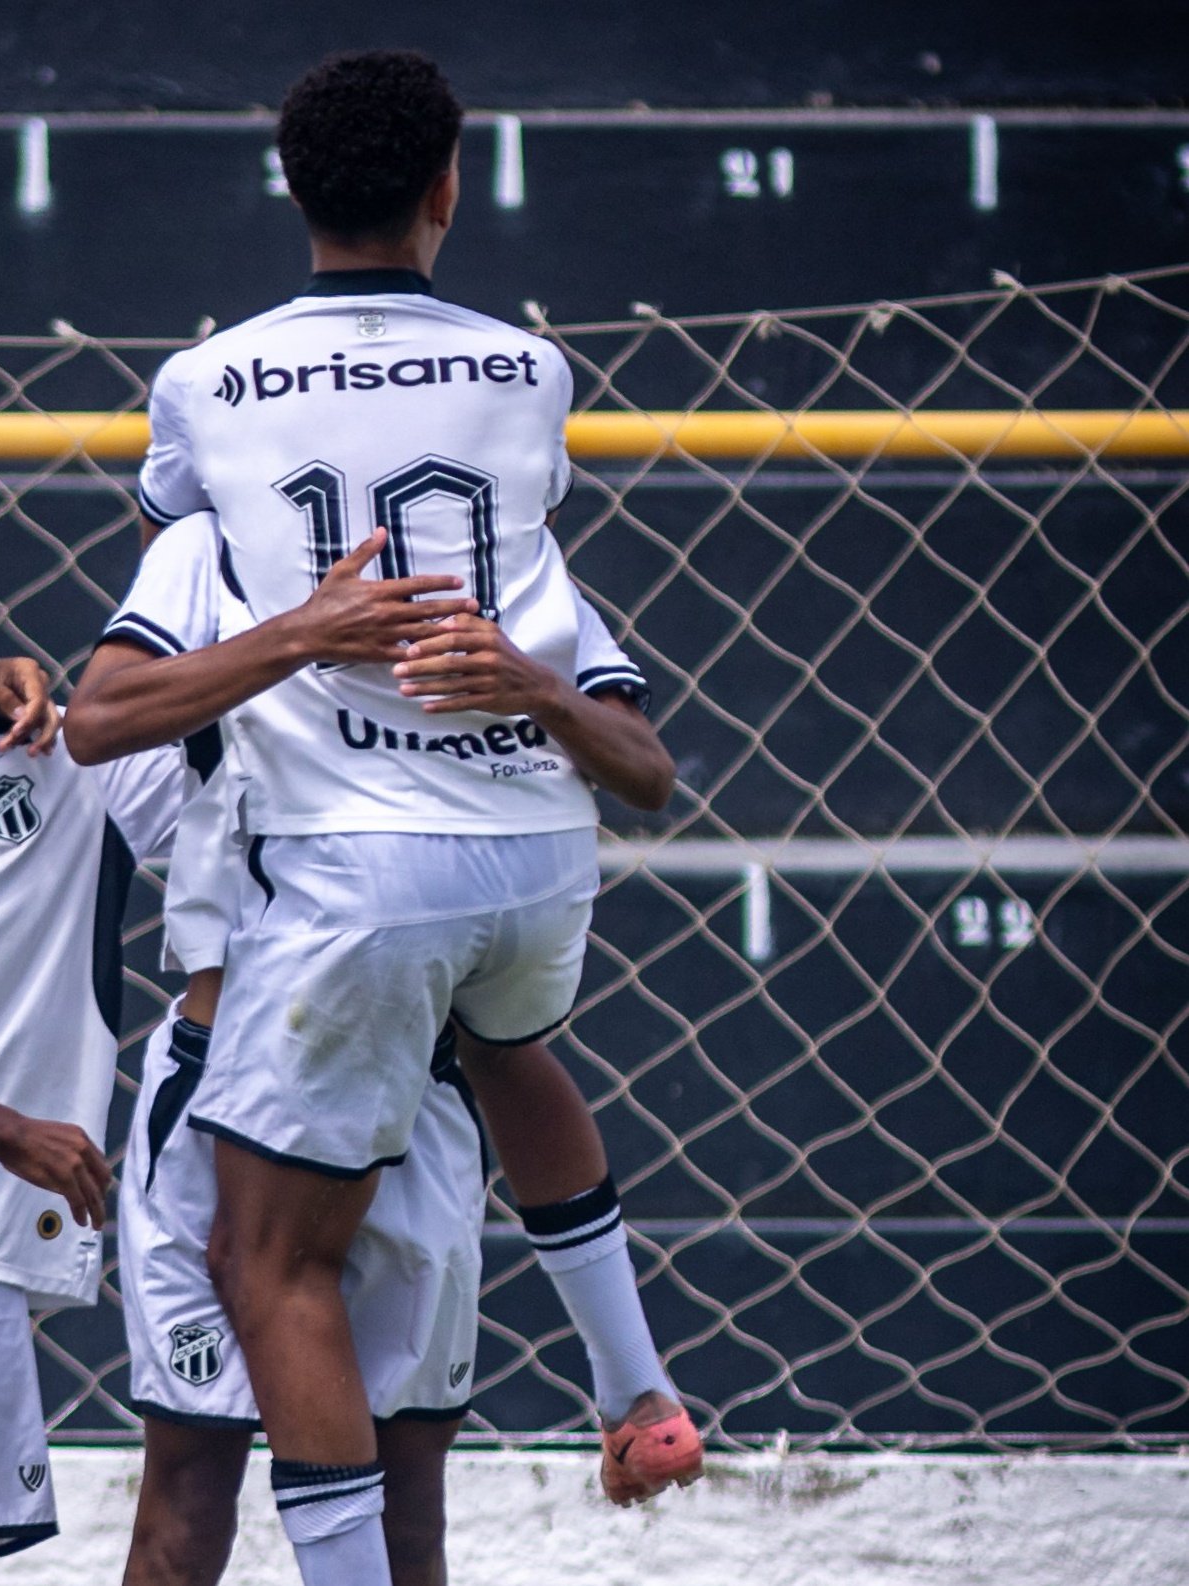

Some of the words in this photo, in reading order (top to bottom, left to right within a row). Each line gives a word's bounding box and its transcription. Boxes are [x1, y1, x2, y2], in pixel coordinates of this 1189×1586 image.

[721, 146, 794, 198] 21
[253, 350, 539, 401] brisanet
[271, 452, 500, 676] 10
